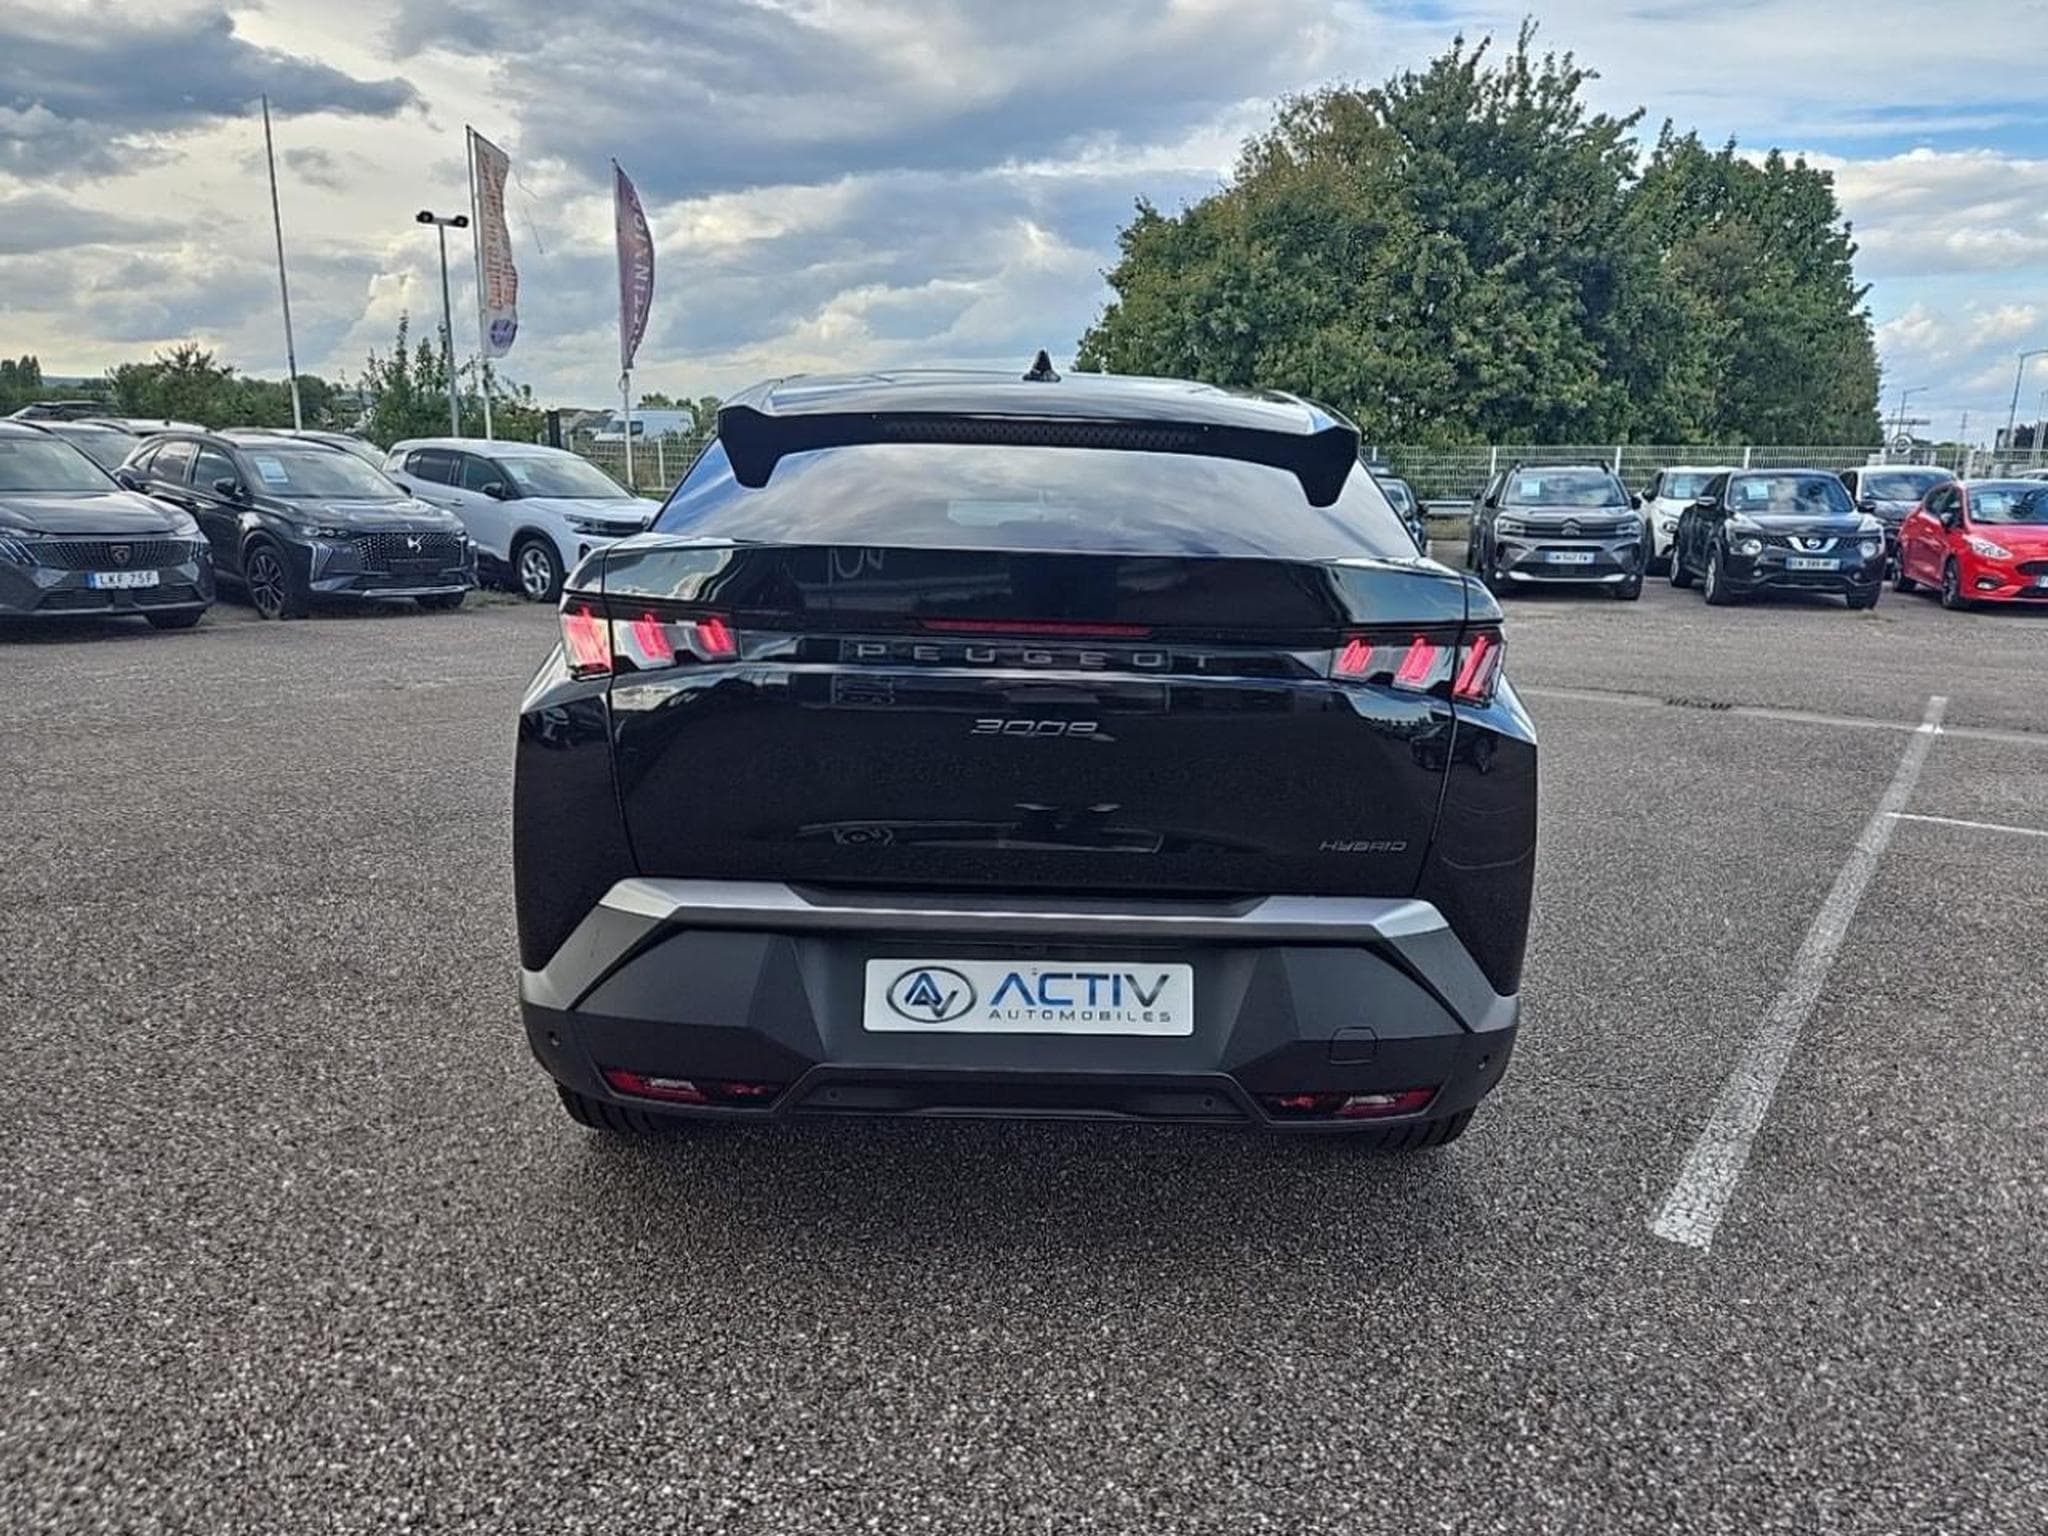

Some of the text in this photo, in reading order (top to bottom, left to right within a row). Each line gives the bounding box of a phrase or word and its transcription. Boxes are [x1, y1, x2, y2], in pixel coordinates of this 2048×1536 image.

[857, 643, 1215, 668] PEUGEOT
[969, 718, 1099, 737] 3008
[1318, 840, 1407, 853] HYBRID
[990, 972, 1171, 1008] ACTIV
[988, 1008, 1172, 1023] AUTOMOBILES
